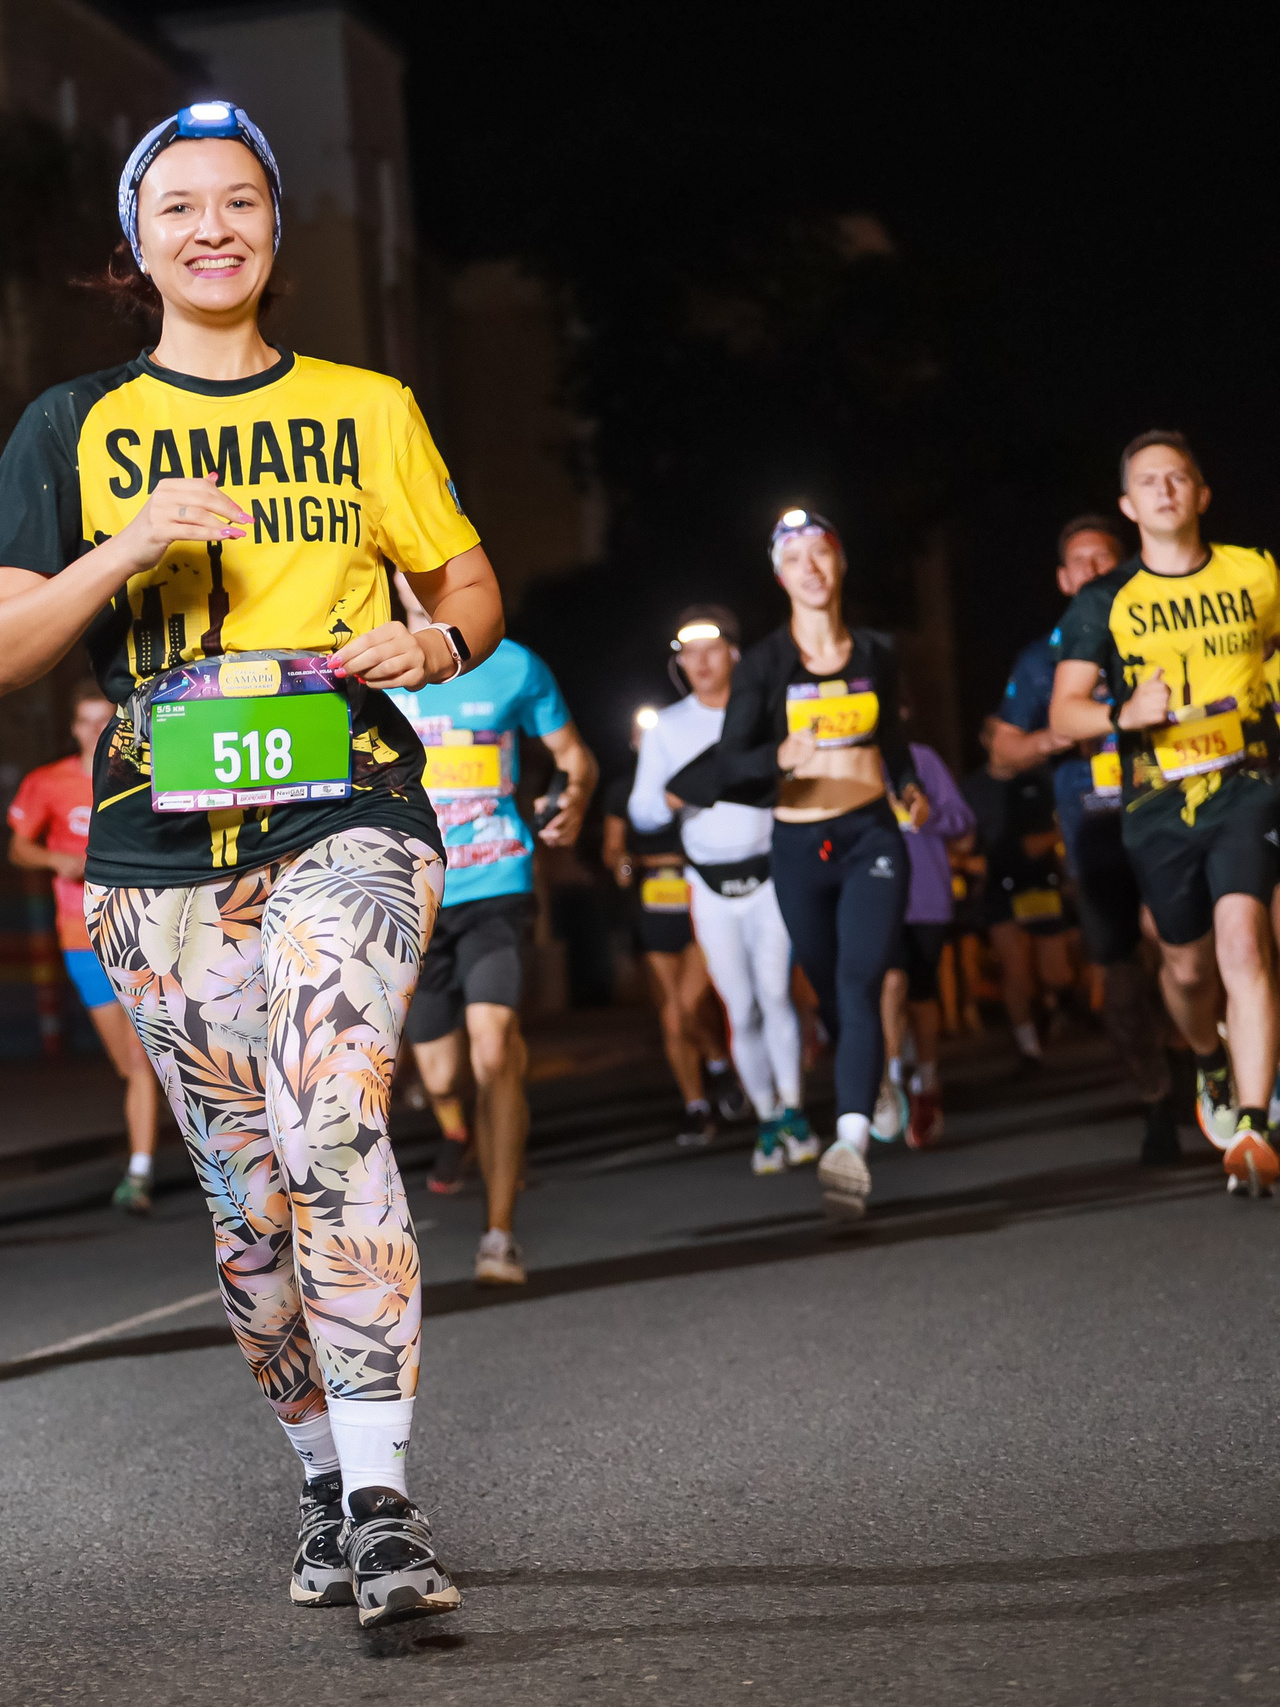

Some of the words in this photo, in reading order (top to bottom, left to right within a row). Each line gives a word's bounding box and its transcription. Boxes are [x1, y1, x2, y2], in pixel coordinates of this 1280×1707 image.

[106, 417, 362, 499] SAMARA
[251, 495, 362, 548] NIGHT
[1128, 589, 1257, 636] SAMARA
[225, 672, 274, 685] САМАРЫ
[156, 705, 172, 714] 5/5
[213, 728, 293, 784] 518
